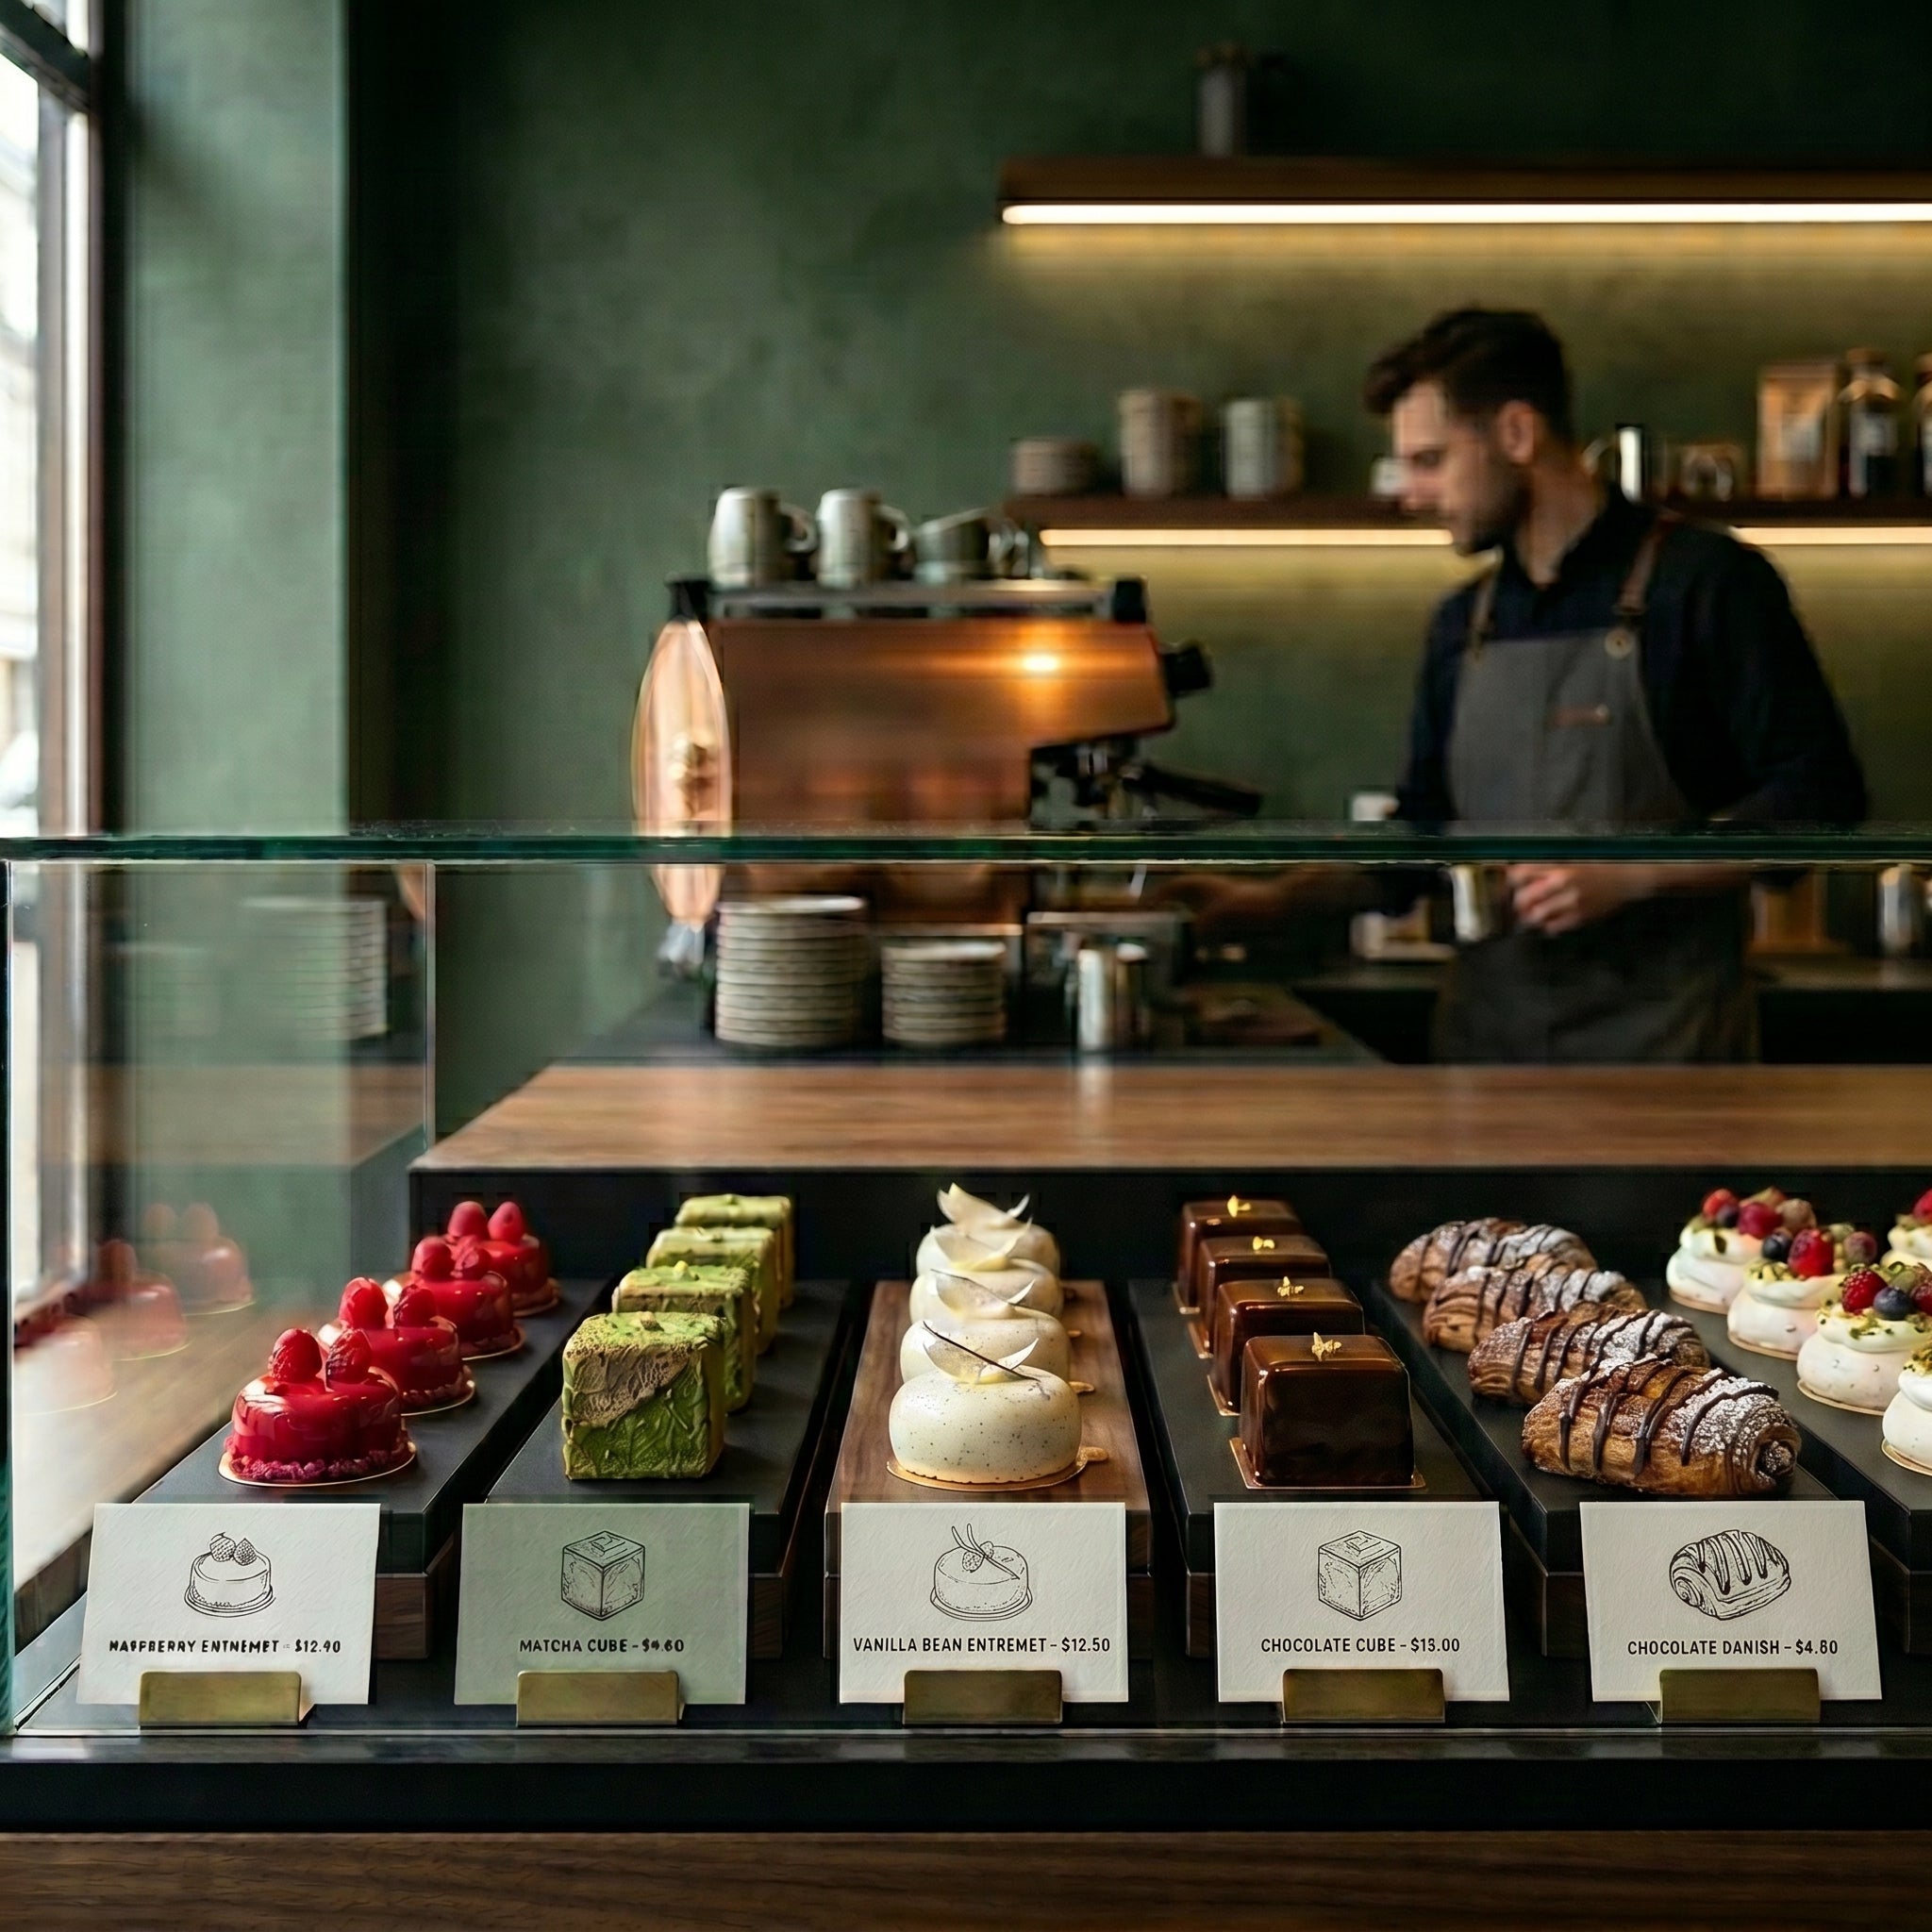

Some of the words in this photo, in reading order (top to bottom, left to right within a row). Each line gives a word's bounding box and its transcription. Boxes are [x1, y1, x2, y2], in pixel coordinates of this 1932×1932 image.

[520, 1639, 582, 1653] MATCHA
[588, 1639, 627, 1653] CUBE
[854, 1638, 917, 1652] VANILLA
[923, 1638, 961, 1652] BEAN
[968, 1638, 1046, 1652] ENTREMET
[1061, 1637, 1109, 1653] $12.50
[1261, 1638, 1350, 1653] CHOCOLATE
[1357, 1638, 1395, 1653] CUBE
[1411, 1637, 1459, 1653] $13.00
[1628, 1641, 1717, 1655] CHOCOLATE
[1724, 1640, 1779, 1655] DANISH
